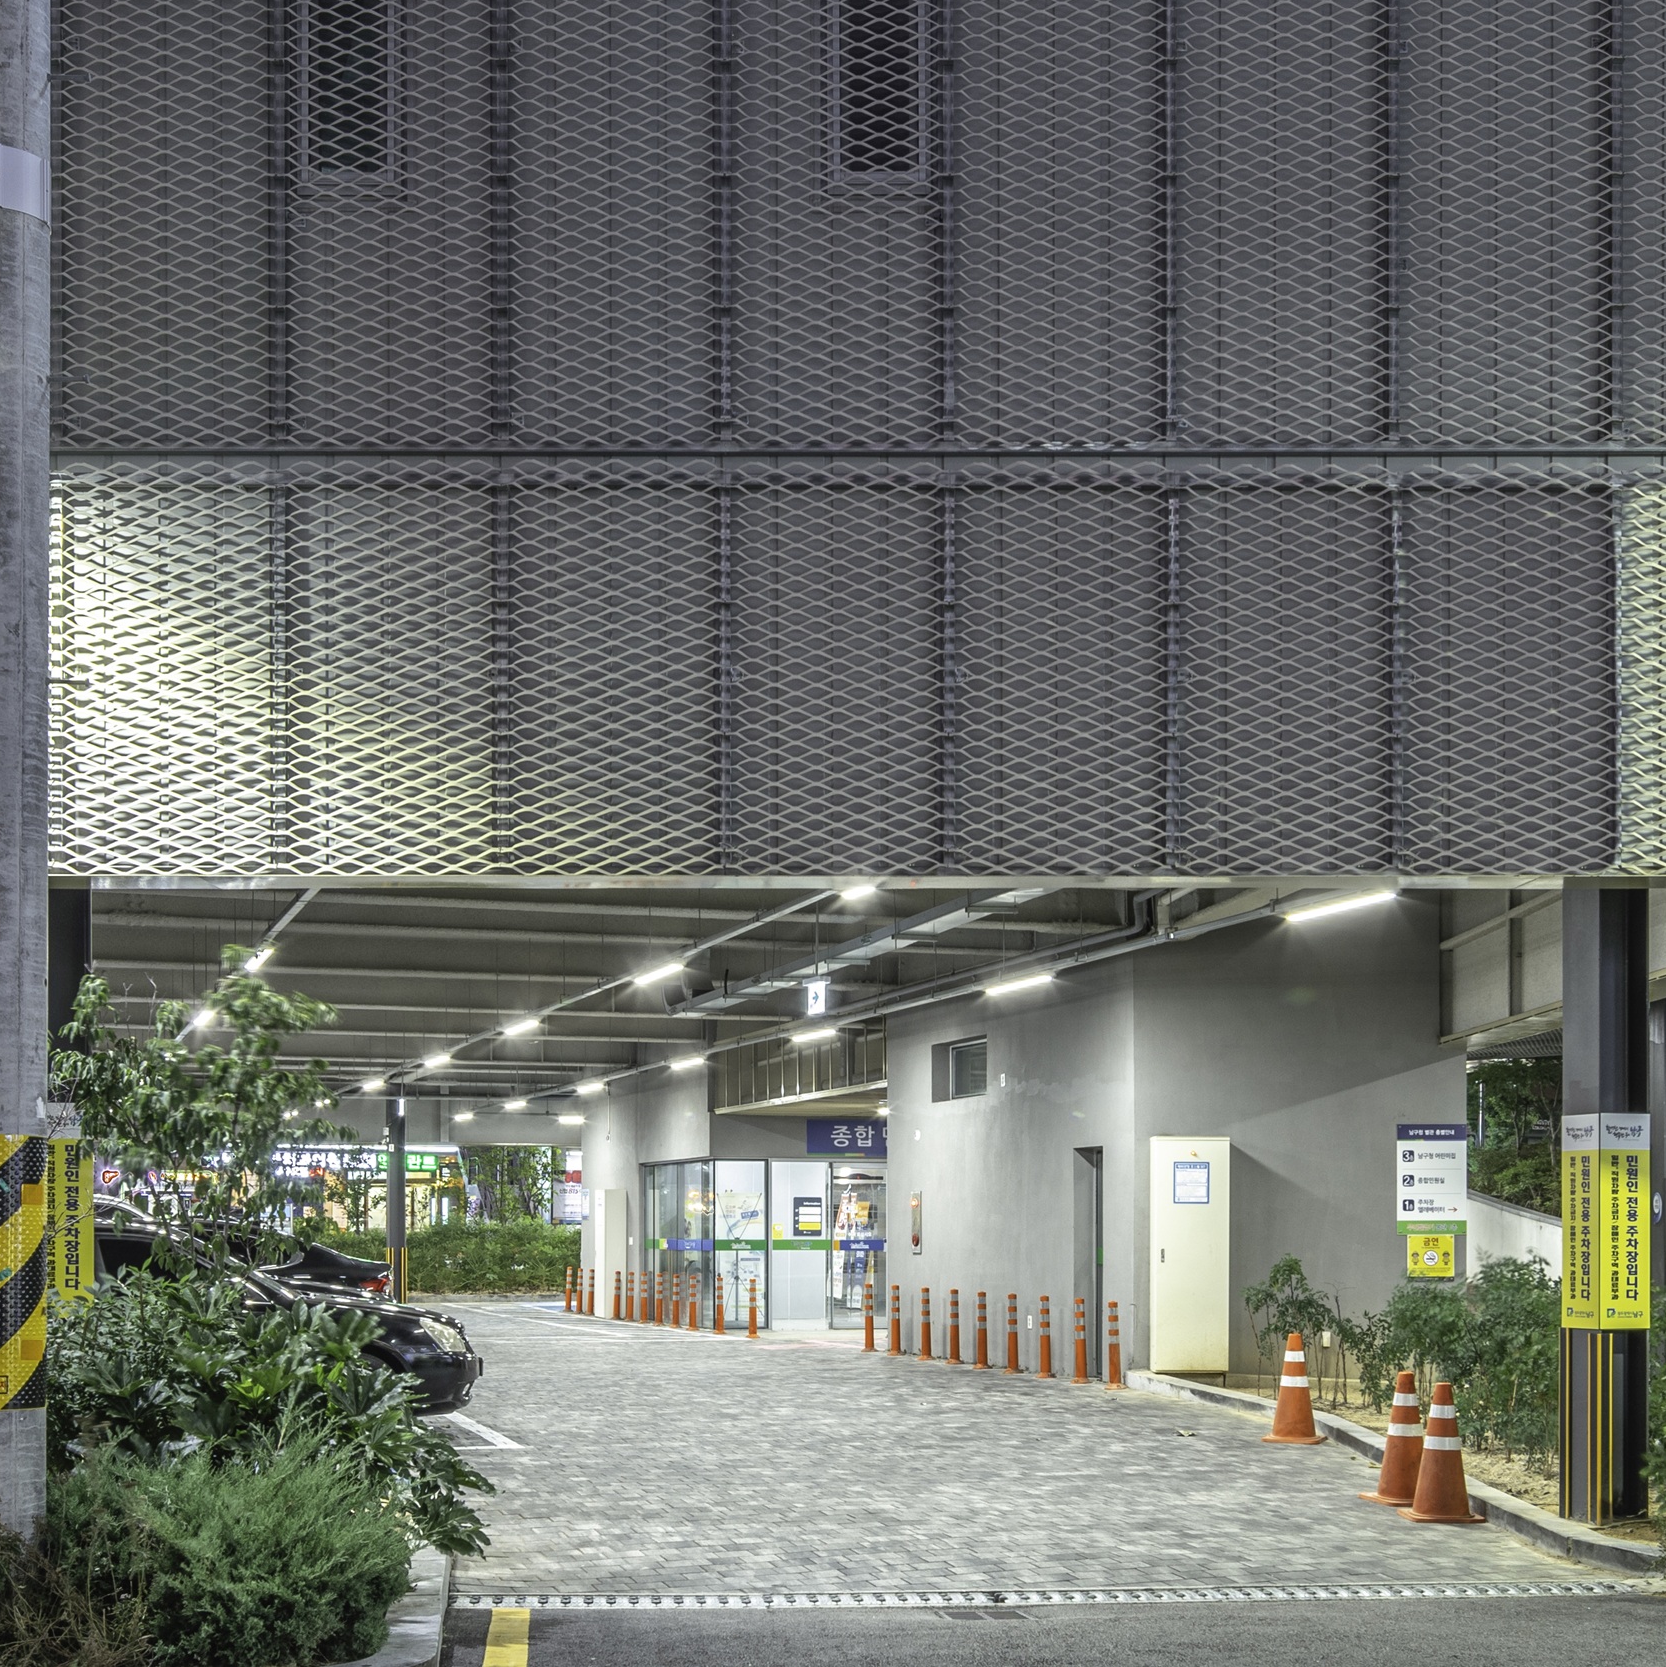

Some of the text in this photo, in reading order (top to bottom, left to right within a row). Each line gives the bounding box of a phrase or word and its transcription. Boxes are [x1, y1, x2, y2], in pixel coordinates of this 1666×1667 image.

[64, 1185, 80, 1212] 전용
[1423, 1237, 1439, 1246] 금연
[1581, 1155, 1591, 1301] 민원인 전용 주차장입니다
[1626, 1155, 1639, 1301] 민원인 전용 주차장입니다
